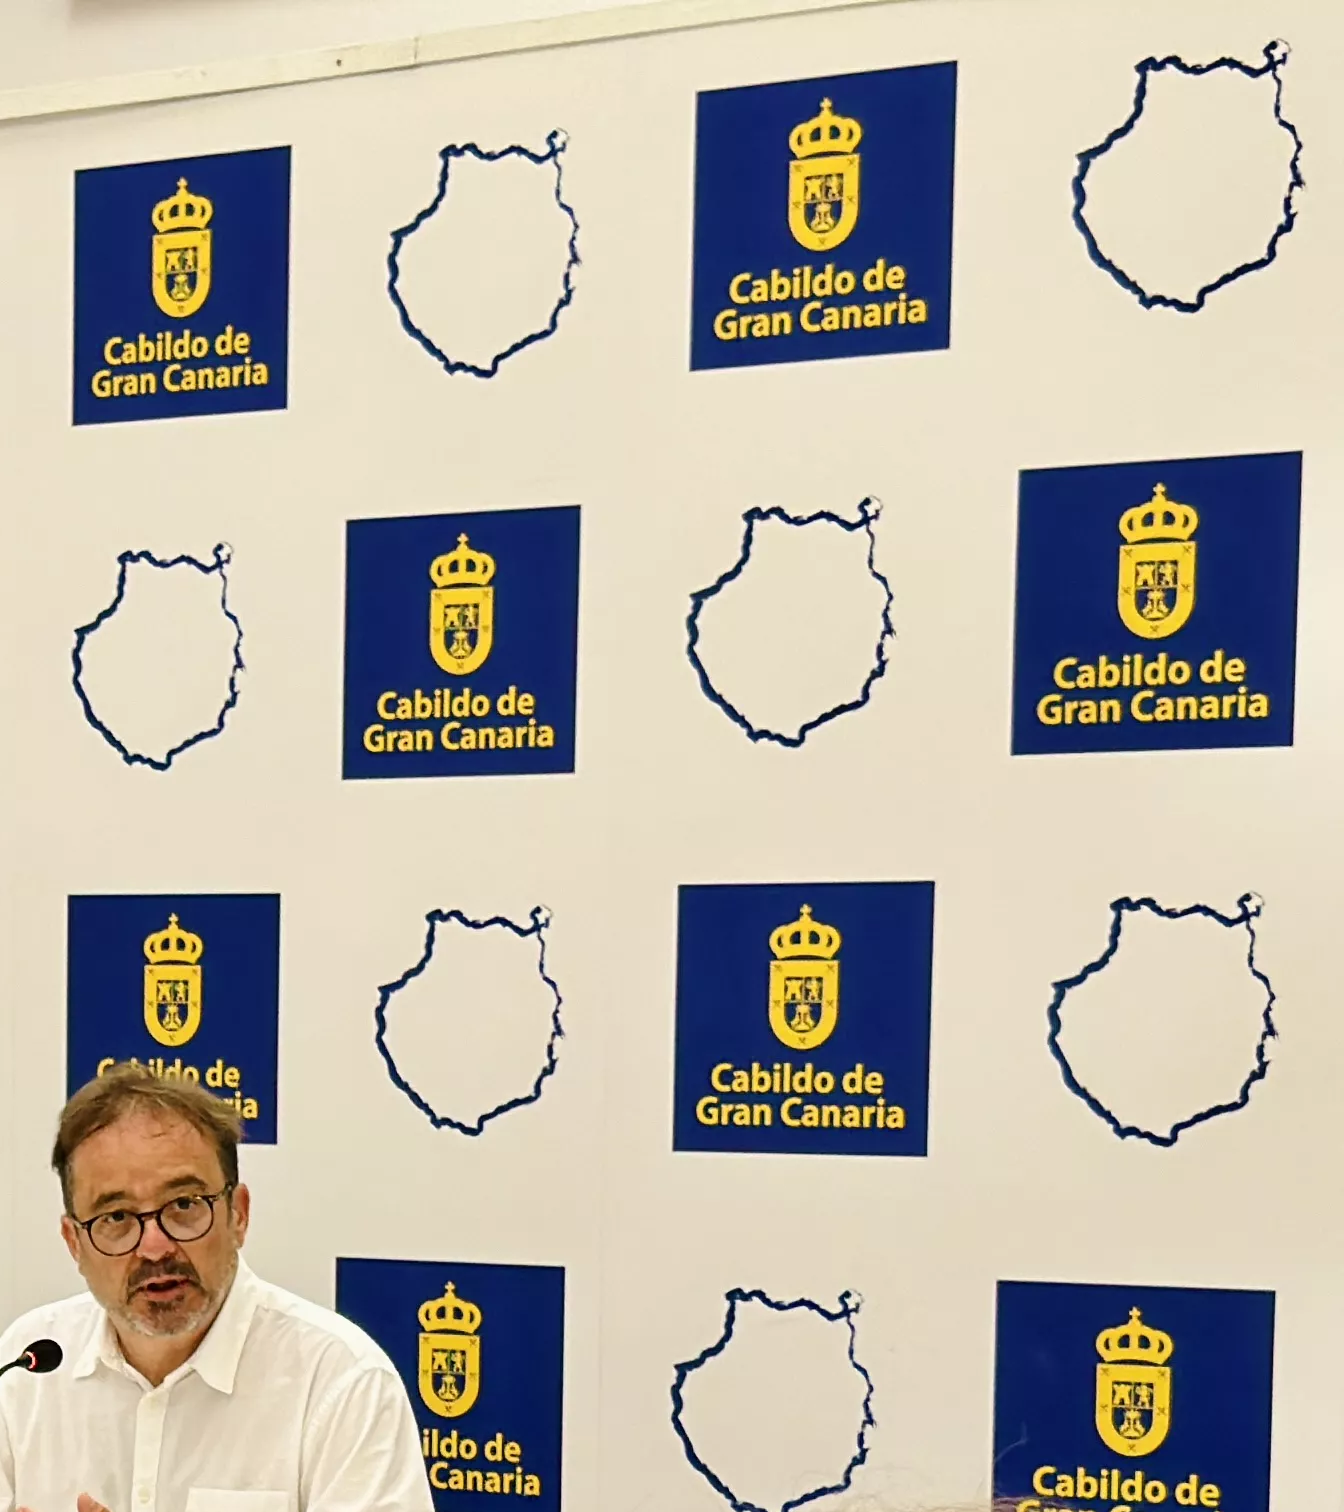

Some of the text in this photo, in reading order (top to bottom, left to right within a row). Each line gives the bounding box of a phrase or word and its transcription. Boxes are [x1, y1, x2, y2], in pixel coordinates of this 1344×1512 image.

[729, 258, 907, 305] Cabildo de
[713, 292, 928, 341] Gran Canaria
[103, 325, 251, 366] Cabildo de
[91, 357, 269, 398] Gran Canaria
[1053, 649, 1247, 690] Cabildo de
[376, 686, 536, 721] Cabildo de
[1036, 685, 1269, 726] Gran Canaria
[363, 718, 555, 753] Gran Canaria
[205, 1058, 241, 1088] de
[711, 1062, 885, 1095] Cabildo de
[695, 1095, 906, 1129] Gran Canaria
[483, 1432, 522, 1464] de
[428, 1461, 541, 1497] Canaria
[1032, 1464, 1220, 1507] Cabildo de
